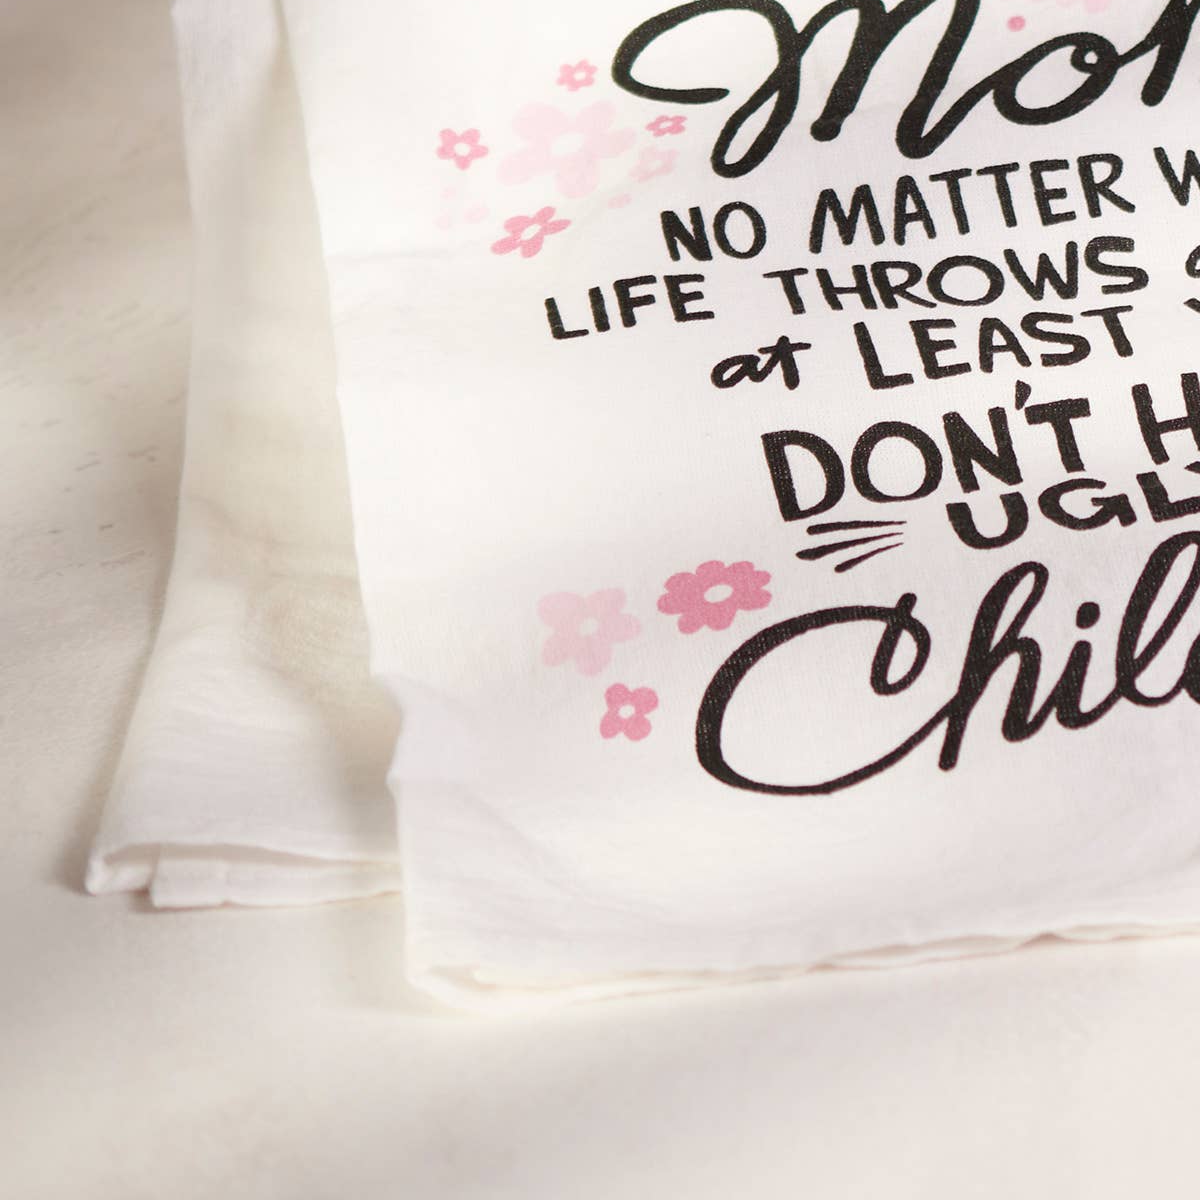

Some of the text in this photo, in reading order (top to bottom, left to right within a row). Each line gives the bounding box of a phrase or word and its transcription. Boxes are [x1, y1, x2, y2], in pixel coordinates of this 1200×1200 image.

[661, 202, 767, 262] NO
[810, 154, 1136, 255] MATTER
[545, 273, 715, 340] LIFE
[763, 235, 1149, 315] THROWS
[711, 335, 812, 391] at
[853, 304, 1134, 390] LEAST
[761, 379, 1092, 522] DON'T
